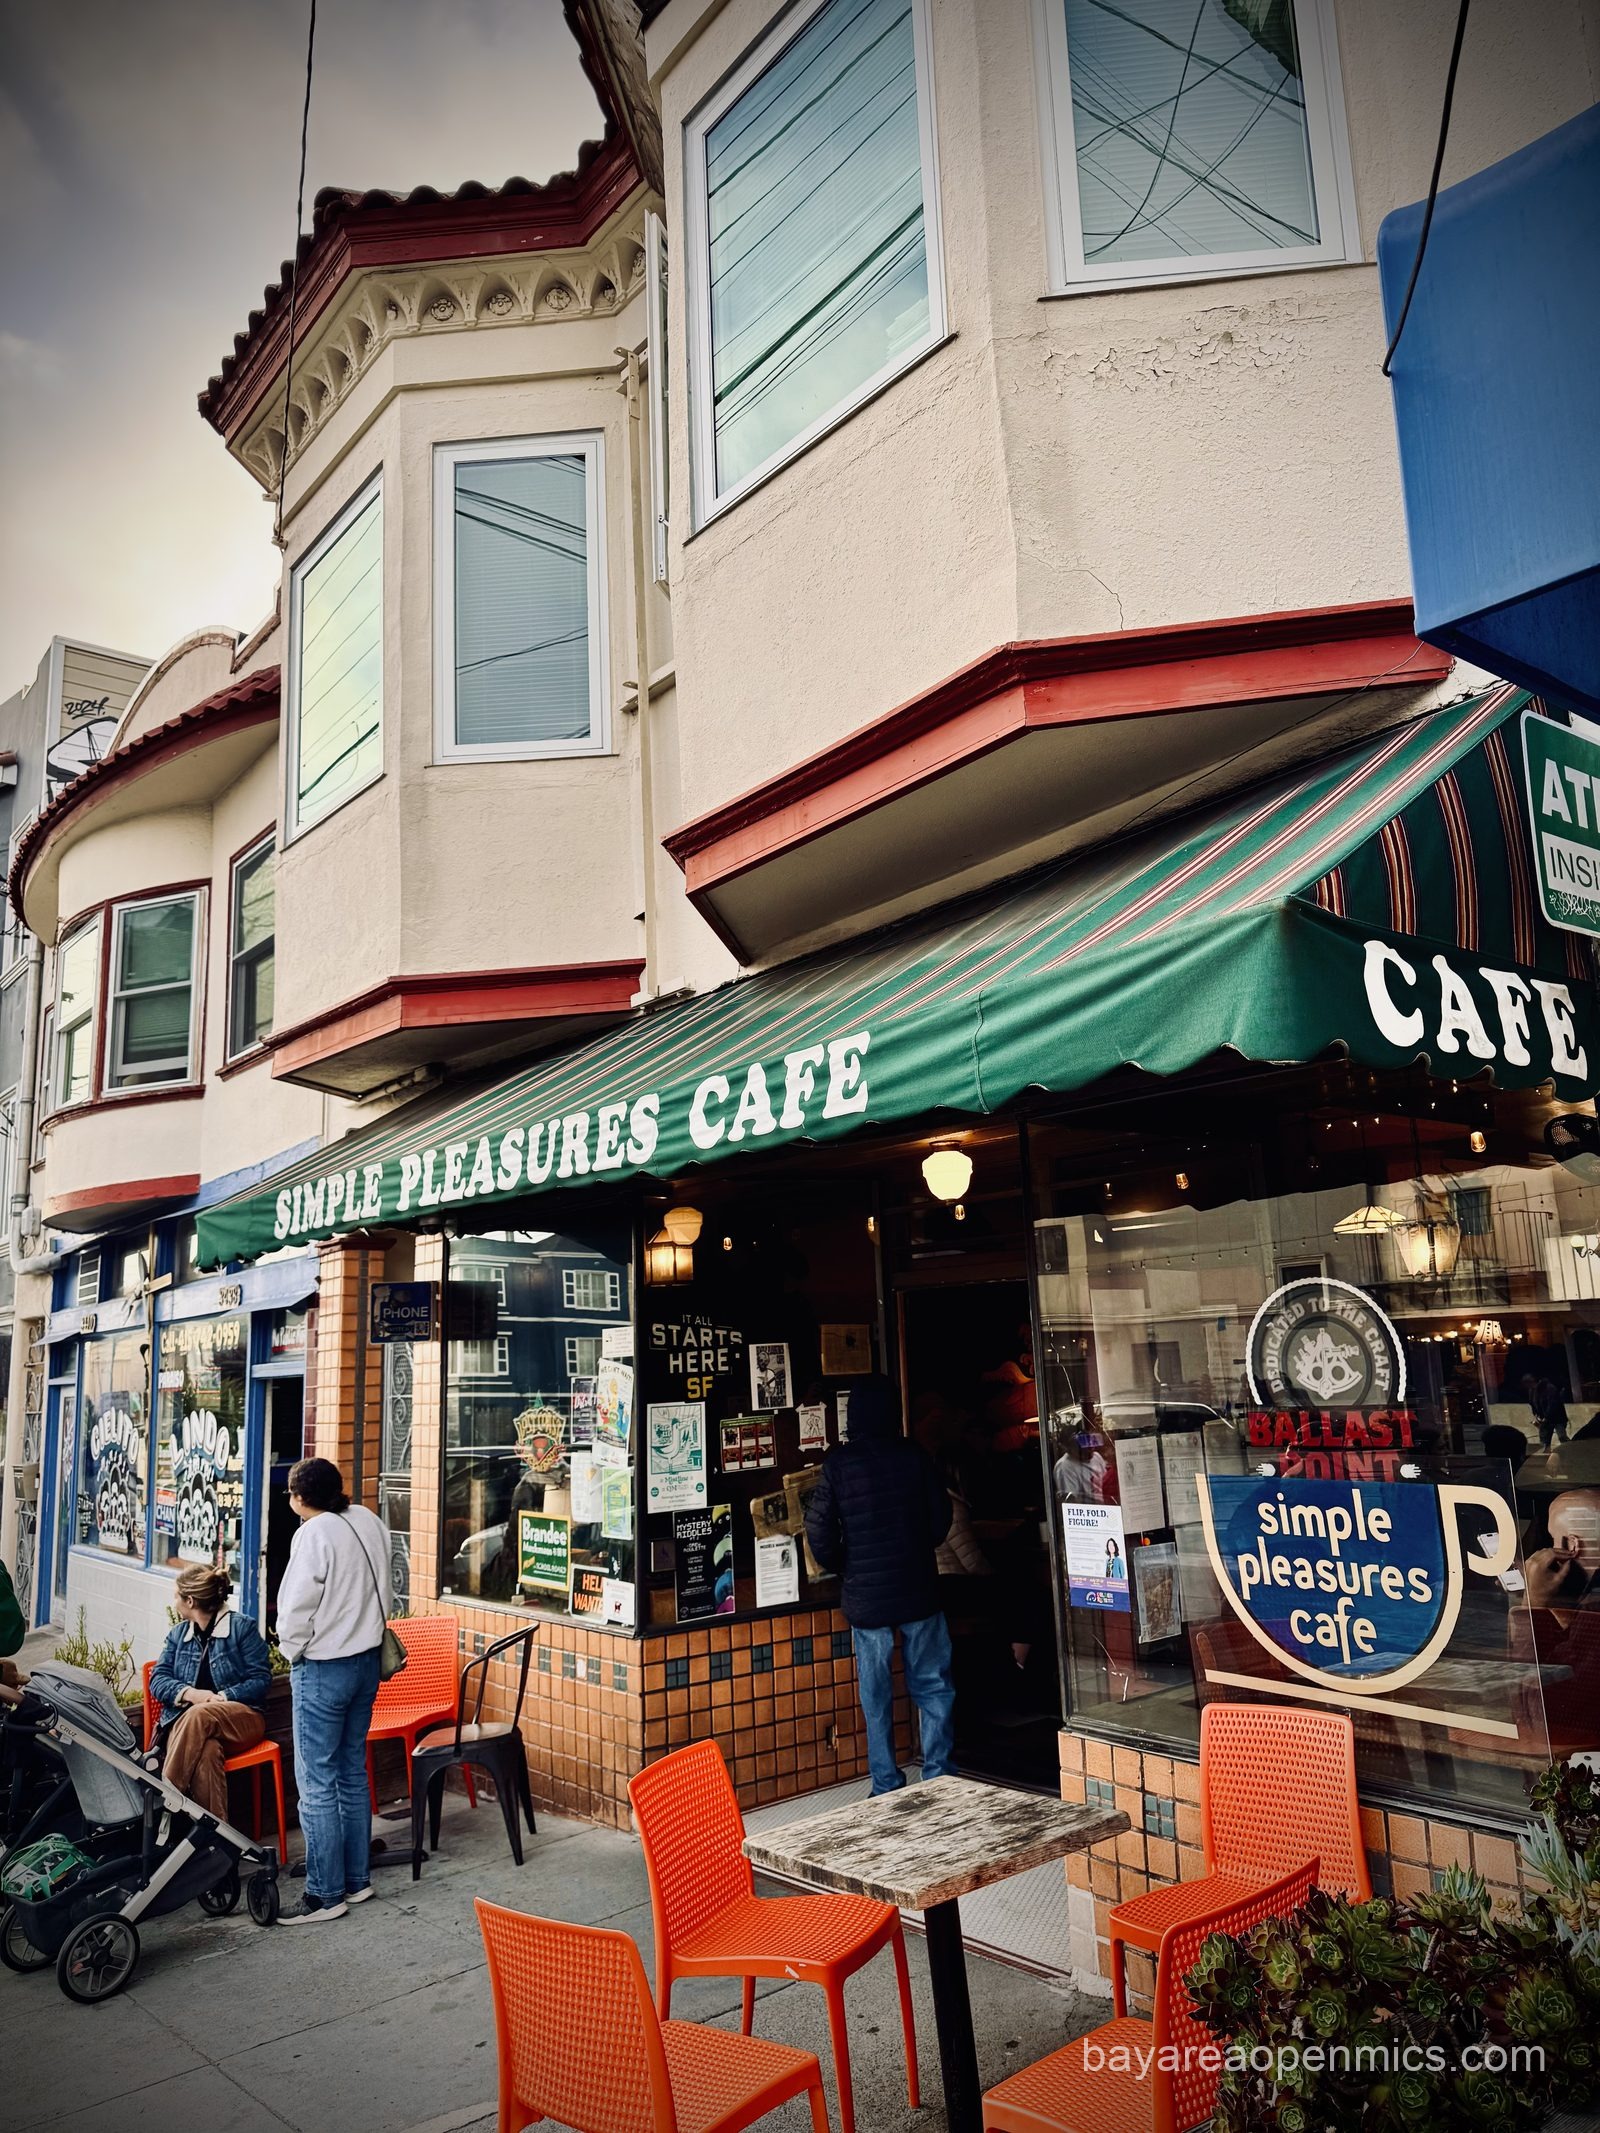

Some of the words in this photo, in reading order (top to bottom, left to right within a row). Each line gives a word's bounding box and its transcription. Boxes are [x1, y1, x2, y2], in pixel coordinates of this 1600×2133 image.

[1550, 846, 1600, 891] INSI
[1363, 940, 1588, 1082] CAFE
[274, 1164, 383, 1240] SIMPLE
[396, 1094, 660, 1211] PLEASURES
[689, 1031, 871, 1150] CAFE
[383, 1306, 429, 1319] PHONE
[682, 1314, 691, 1324] IT
[695, 1316, 713, 1327] ALL
[652, 1323, 743, 1348] STARTS
[1265, 1302, 1306, 1394] DEDICATED
[1308, 1297, 1330, 1313] TO
[1333, 1301, 1367, 1328] THE
[1365, 1327, 1392, 1392] CRAFT
[669, 1348, 729, 1374] HERE
[687, 1376, 714, 1399] SF
[91, 1406, 139, 1465] CIELITO
[170, 1408, 230, 1471] LINDO
[1248, 1410, 1418, 1448] BALLAST
[1278, 1451, 1401, 1483] POINT
[156, 1504, 175, 1523] CHAN
[676, 1520, 711, 1531] MYSTERY
[1068, 1518, 1099, 1527] FIGURE!
[1257, 1488, 1392, 1557] simple
[522, 1518, 567, 1546] Brandee
[676, 1527, 712, 1539] RIDDLES
[582, 1573, 603, 1593] HEL
[1237, 1536, 1433, 1603] pleasures
[574, 1592, 604, 1614] WANTE
[1290, 1597, 1377, 1664] cafe
